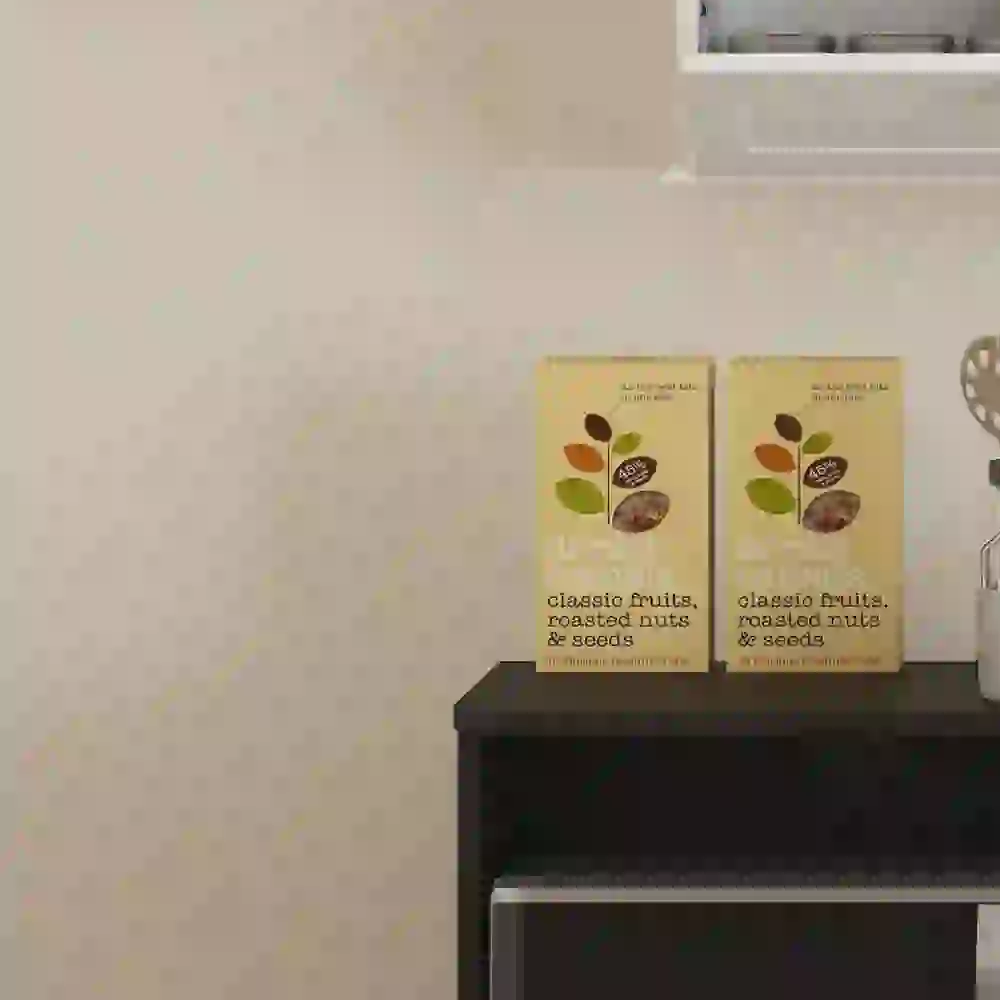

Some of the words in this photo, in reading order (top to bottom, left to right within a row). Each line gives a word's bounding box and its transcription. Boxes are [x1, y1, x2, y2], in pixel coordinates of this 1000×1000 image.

[547, 592, 623, 608] classic
[629, 592, 698, 609] fruits,
[738, 592, 813, 608] classic
[547, 612, 633, 628] roasted
[639, 613, 690, 628] nuts
[738, 611, 820, 628] roasted
[828, 612, 881, 628] nuts
[547, 631, 567, 647] &
[572, 631, 634, 647] seeds
[738, 631, 757, 647] &
[763, 631, 825, 647] seeds
